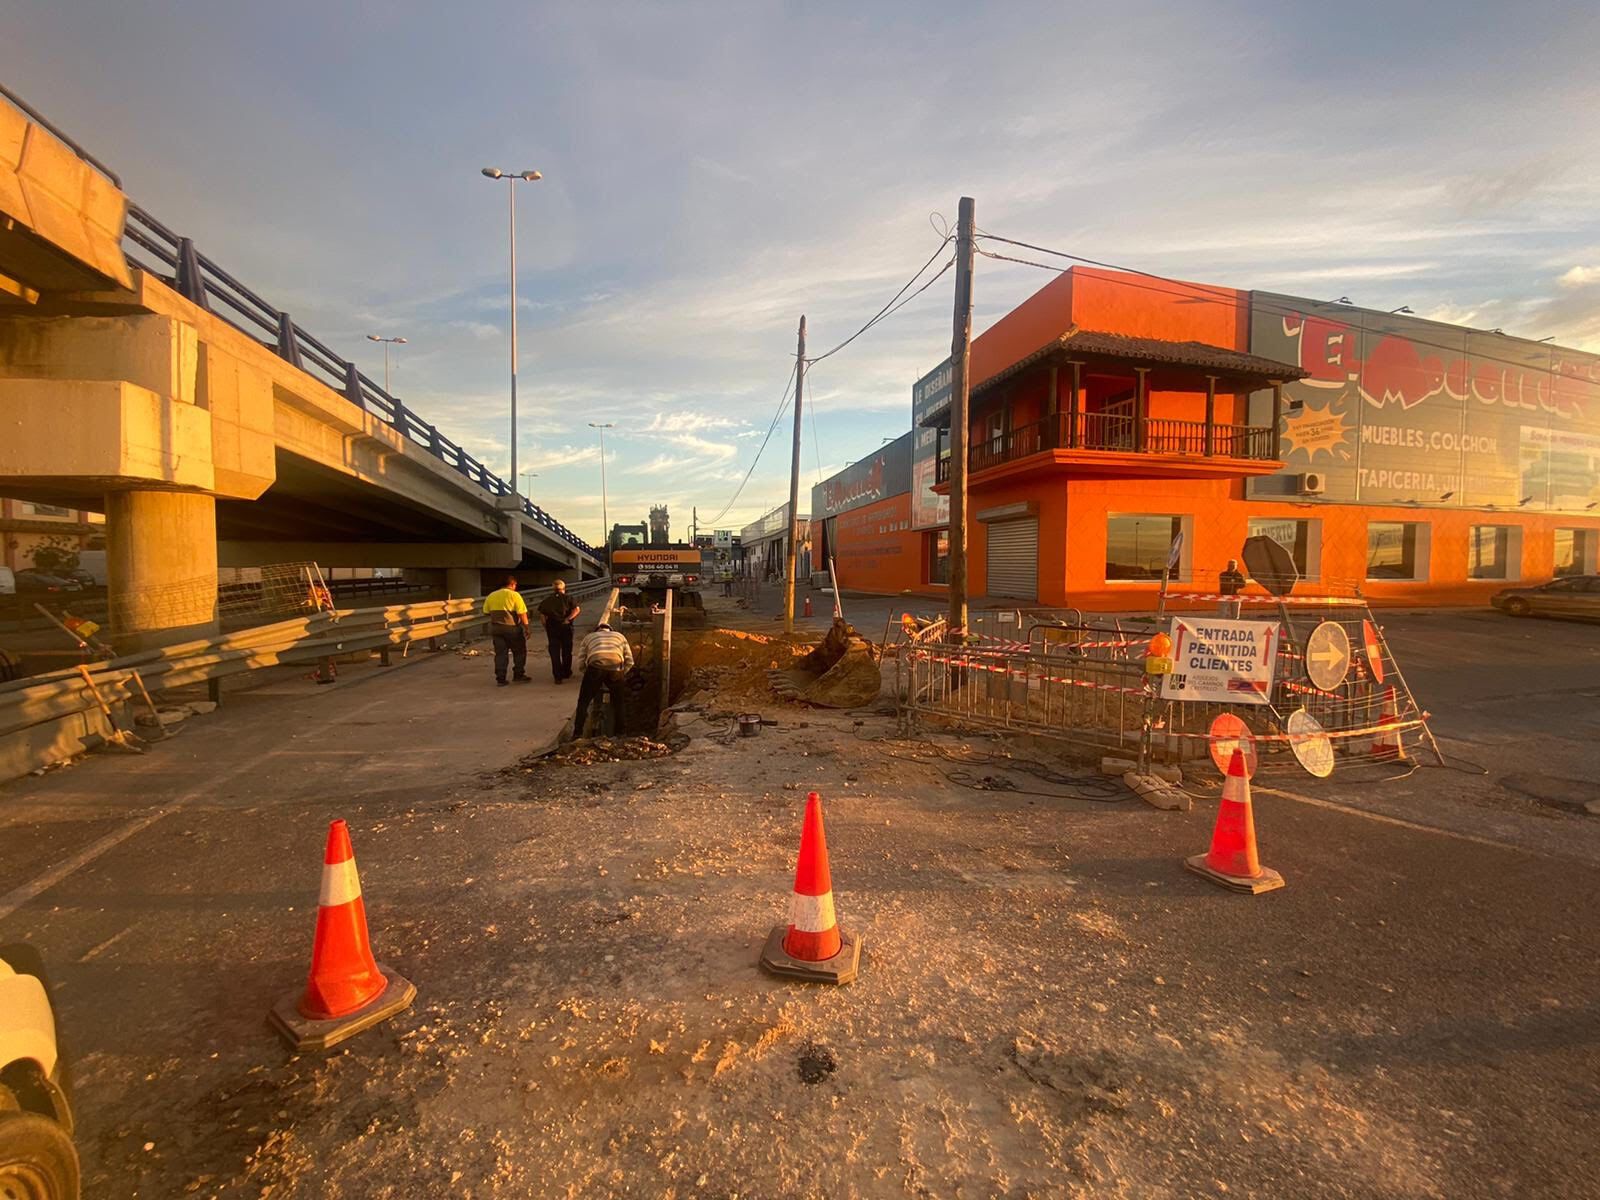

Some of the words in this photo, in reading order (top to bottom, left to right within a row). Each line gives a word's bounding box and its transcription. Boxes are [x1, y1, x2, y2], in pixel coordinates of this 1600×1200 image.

[1196, 628, 1254, 642] ENTRADA
[1188, 642, 1257, 657] PERMITIDA
[1190, 657, 1253, 672] CLIENTES
